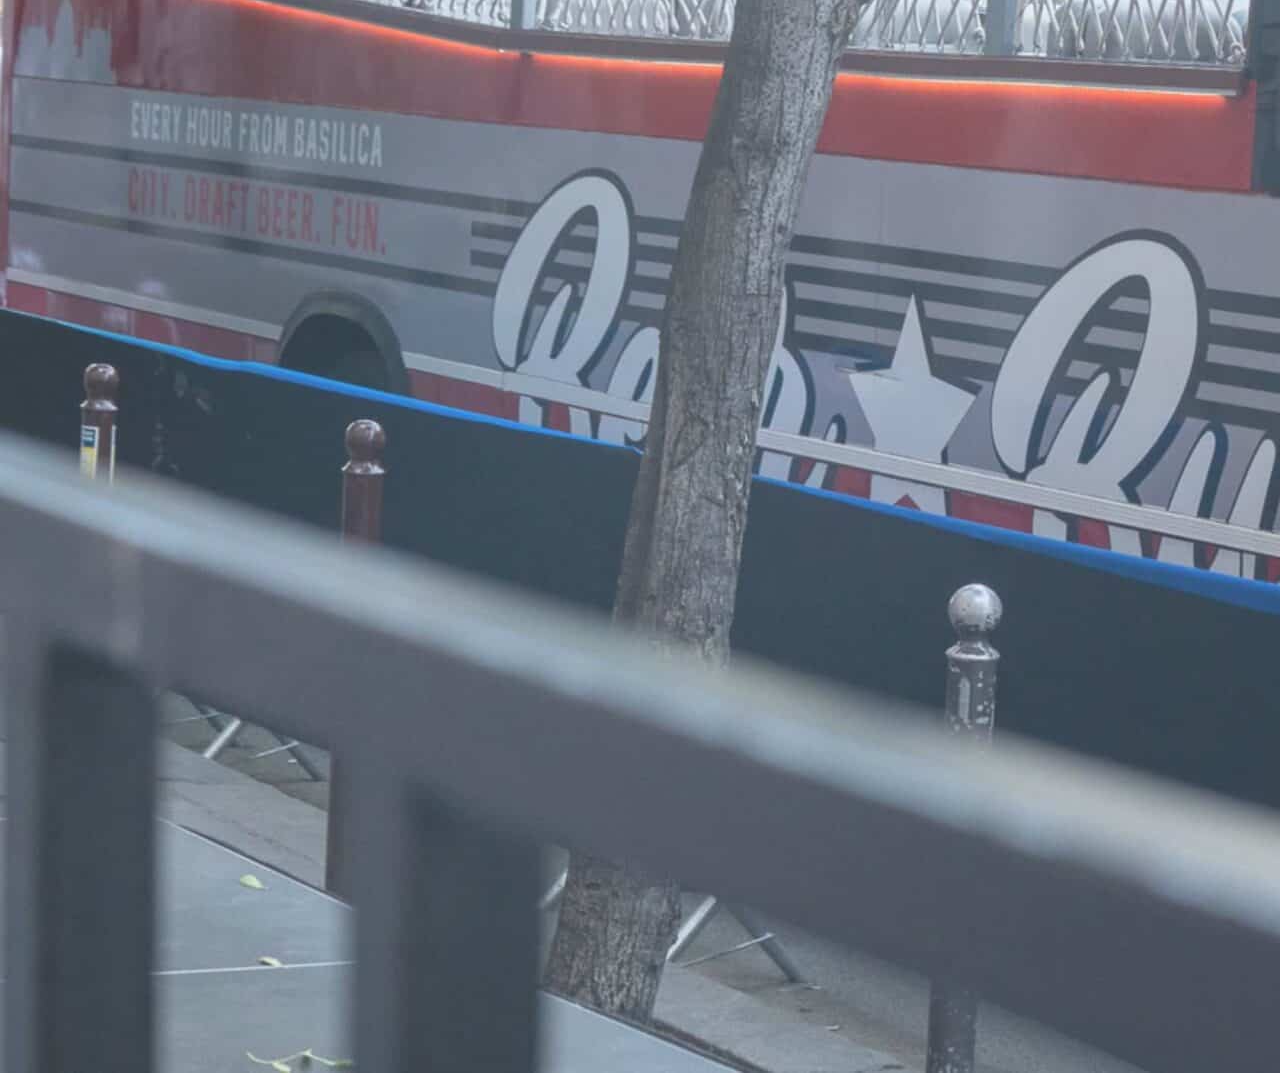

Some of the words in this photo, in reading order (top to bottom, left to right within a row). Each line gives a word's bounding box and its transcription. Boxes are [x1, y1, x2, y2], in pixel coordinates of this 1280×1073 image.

[131, 101, 180, 144] EVERY
[187, 108, 232, 149] HOUR
[239, 112, 287, 155] FROM
[294, 116, 383, 168] BASILICA
[183, 174, 249, 232] DRAFT
[256, 185, 320, 244] BEER.
[331, 196, 387, 256] FUN.
